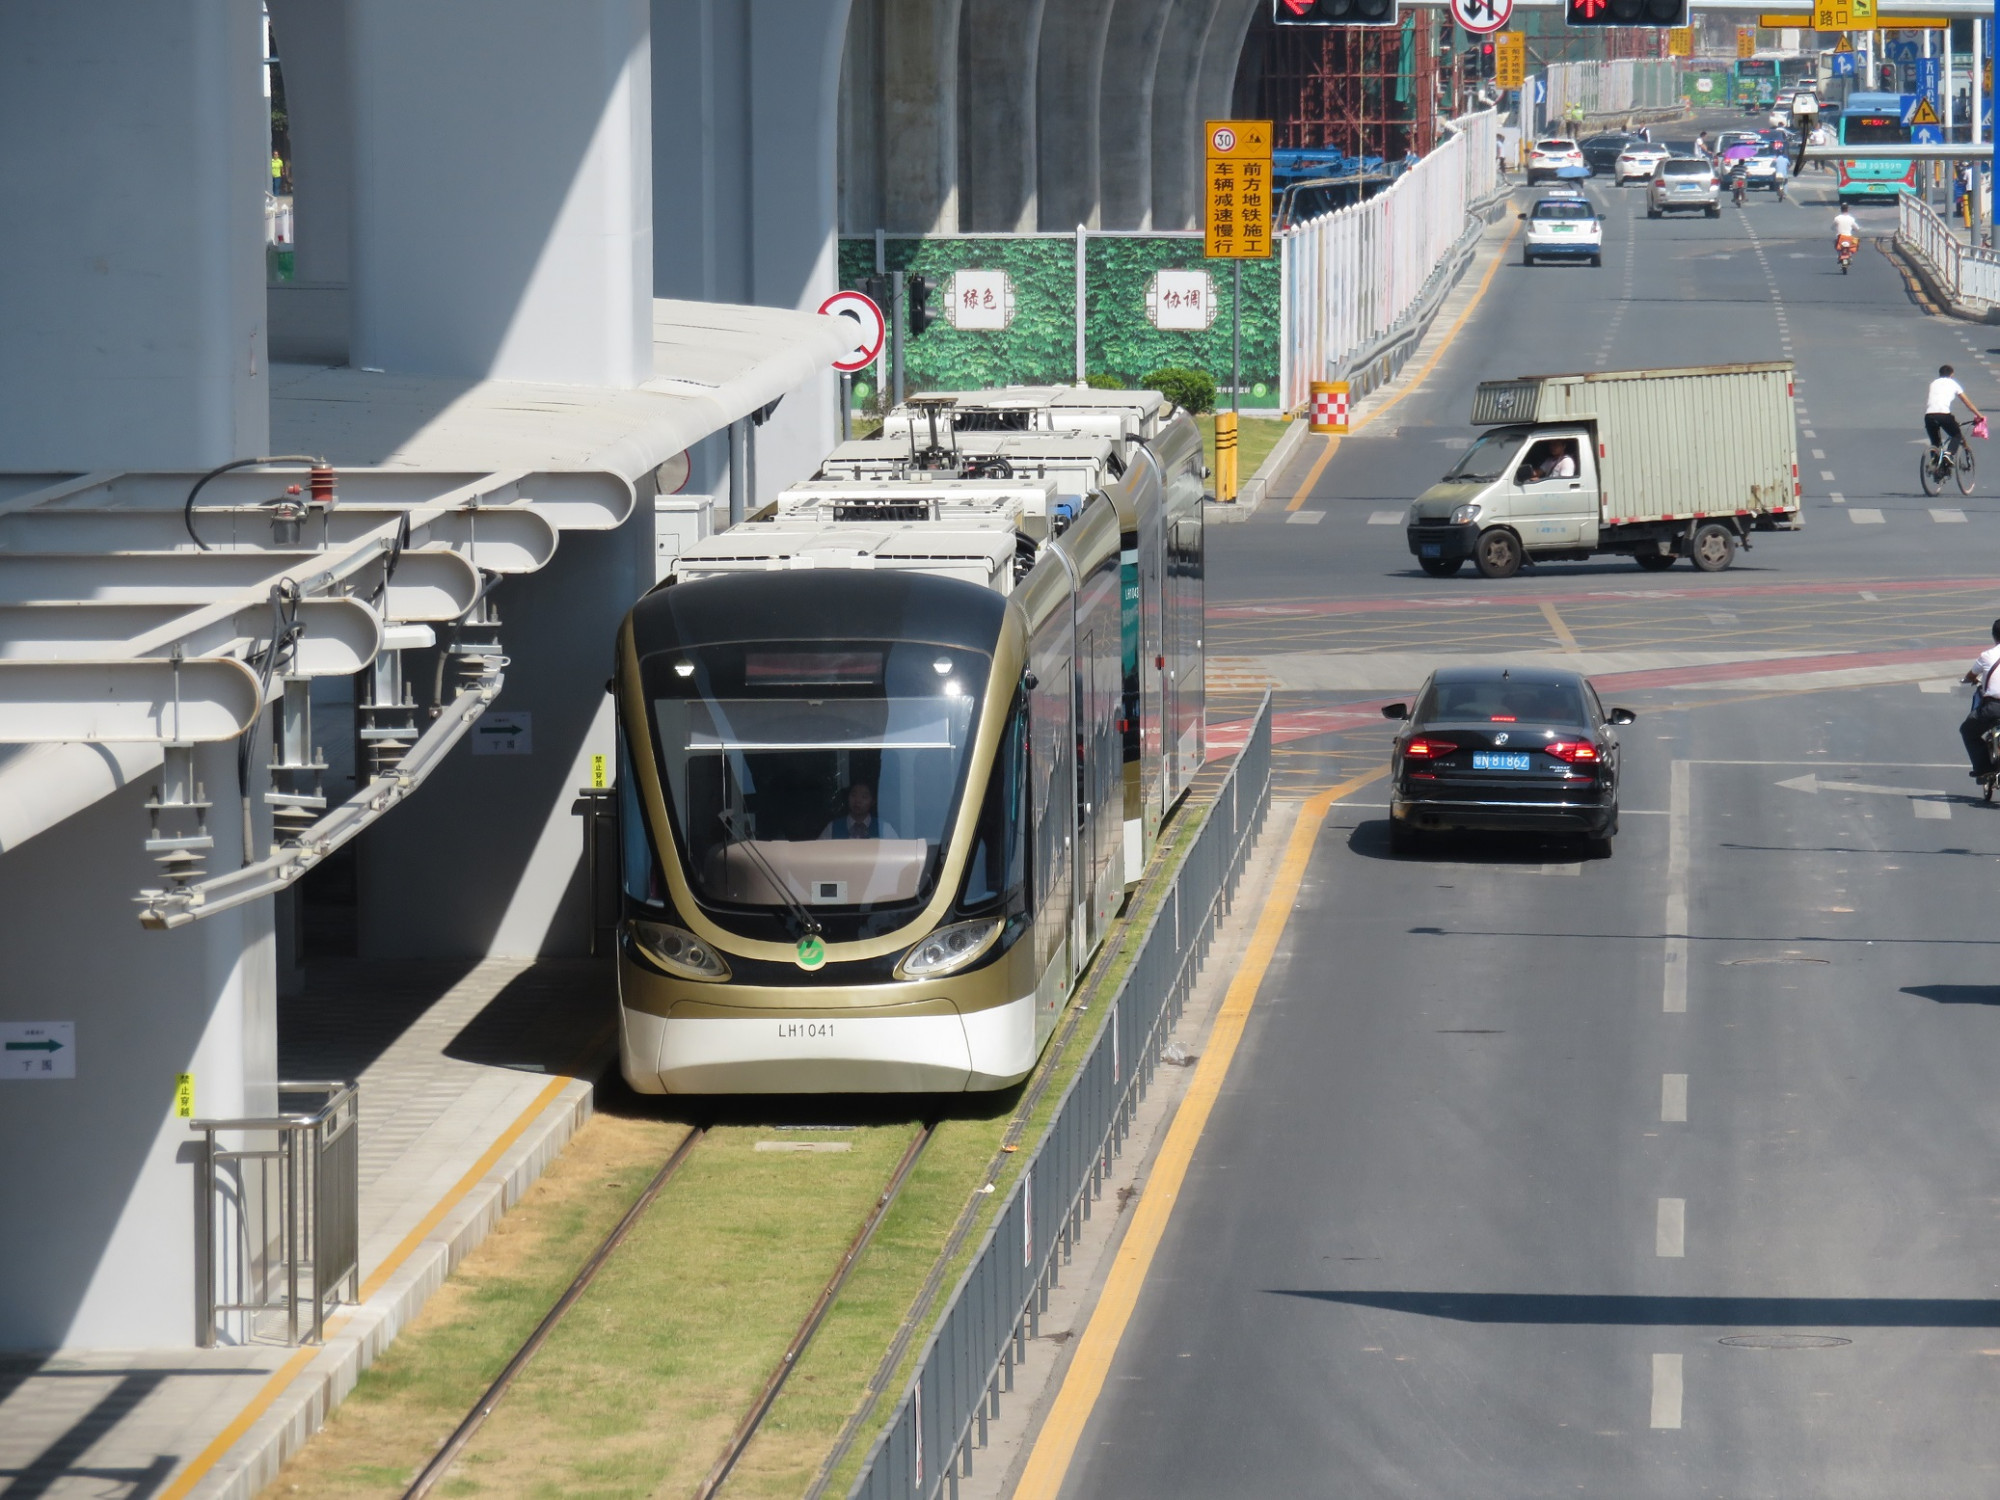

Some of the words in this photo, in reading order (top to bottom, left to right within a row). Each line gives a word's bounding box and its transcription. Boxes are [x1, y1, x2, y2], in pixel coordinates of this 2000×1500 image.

[1820, 10, 1848, 26] 路口
[1217, 134, 1231, 147] 30
[1213, 162, 1234, 253] 车辆减速慢行
[1242, 162, 1263, 252] 前方地铁施工
[963, 287, 997, 310] 绿色
[1163, 289, 1201, 310] 协调
[778, 1023, 834, 1038] LH1041
[180, 1074, 191, 1118] 禁止穿越
